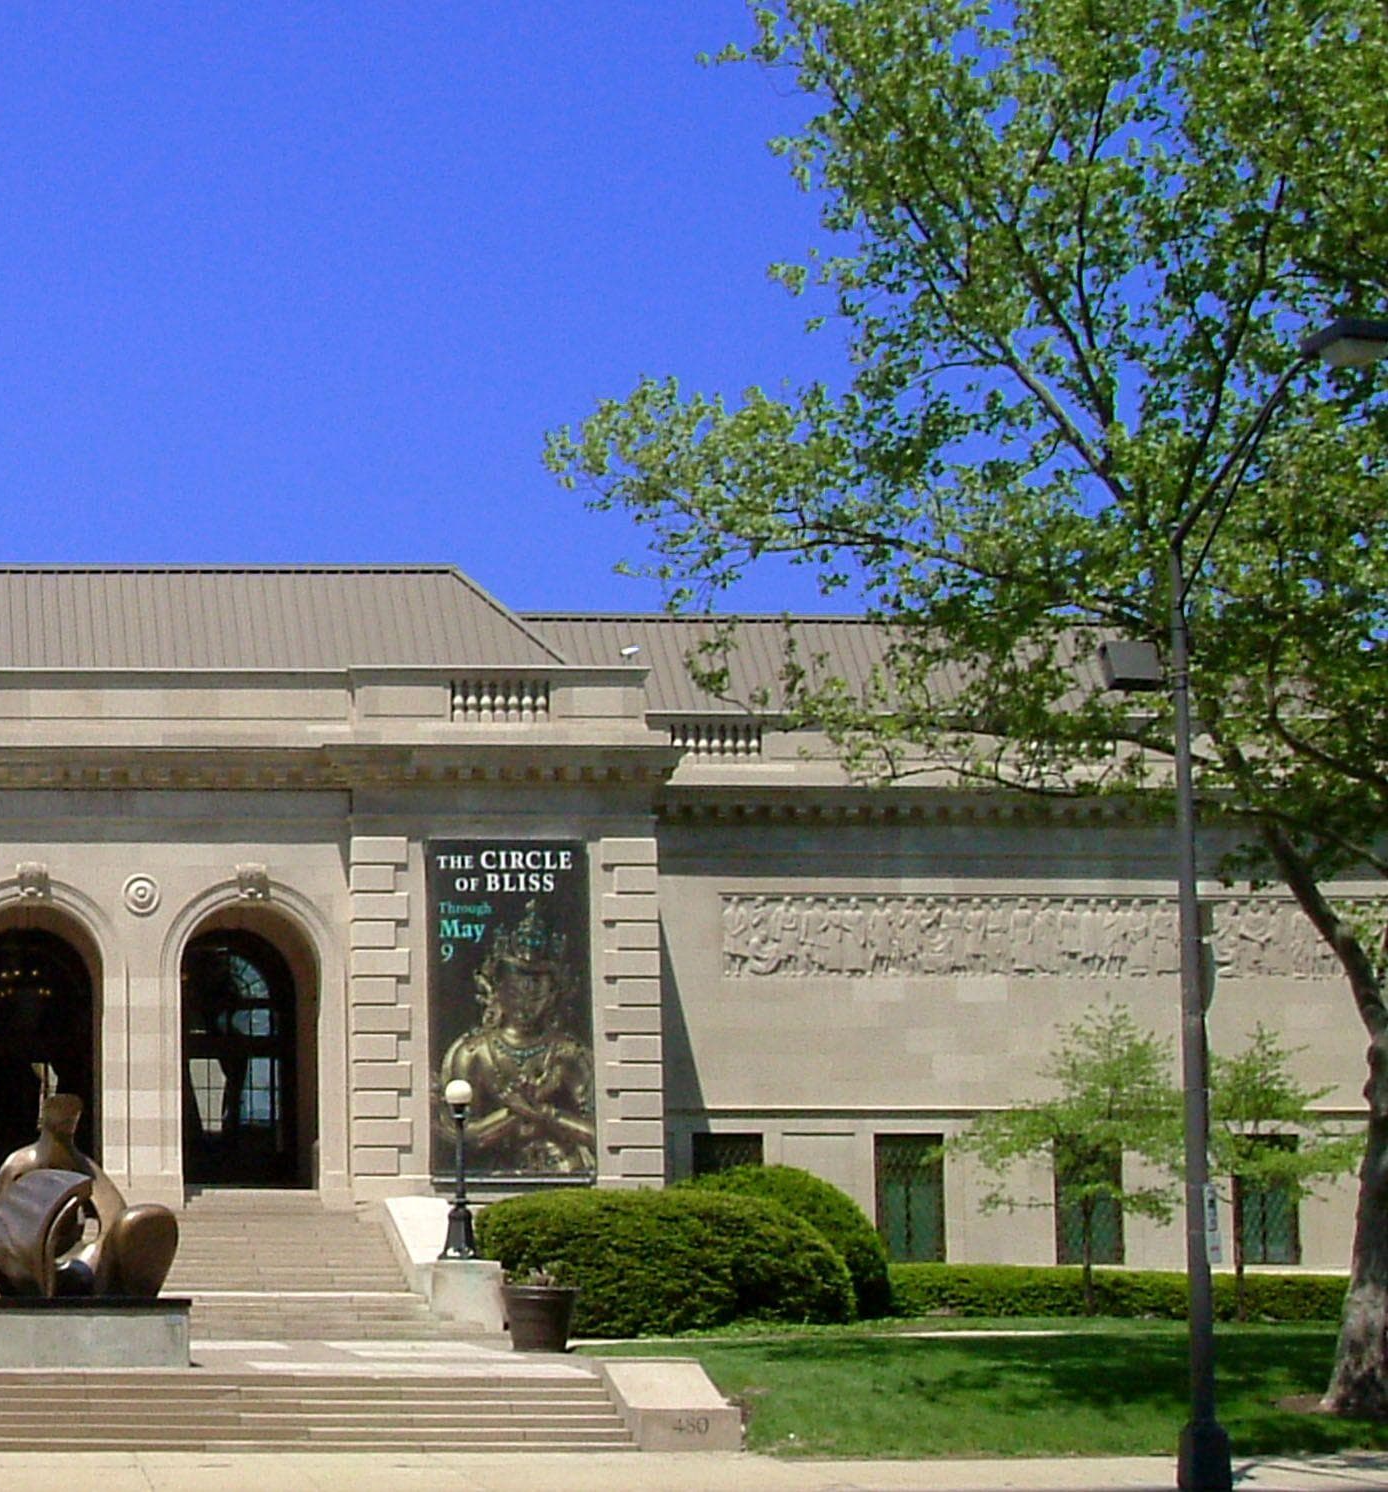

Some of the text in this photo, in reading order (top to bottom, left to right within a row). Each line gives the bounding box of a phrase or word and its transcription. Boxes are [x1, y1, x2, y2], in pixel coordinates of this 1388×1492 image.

[436, 850, 573, 870] THE CIRCLE
[455, 873, 555, 893] OF BLISS
[439, 901, 493, 917] Through
[439, 919, 486, 943] May
[441, 943, 454, 962] 9
[672, 1416, 710, 1435] 480
